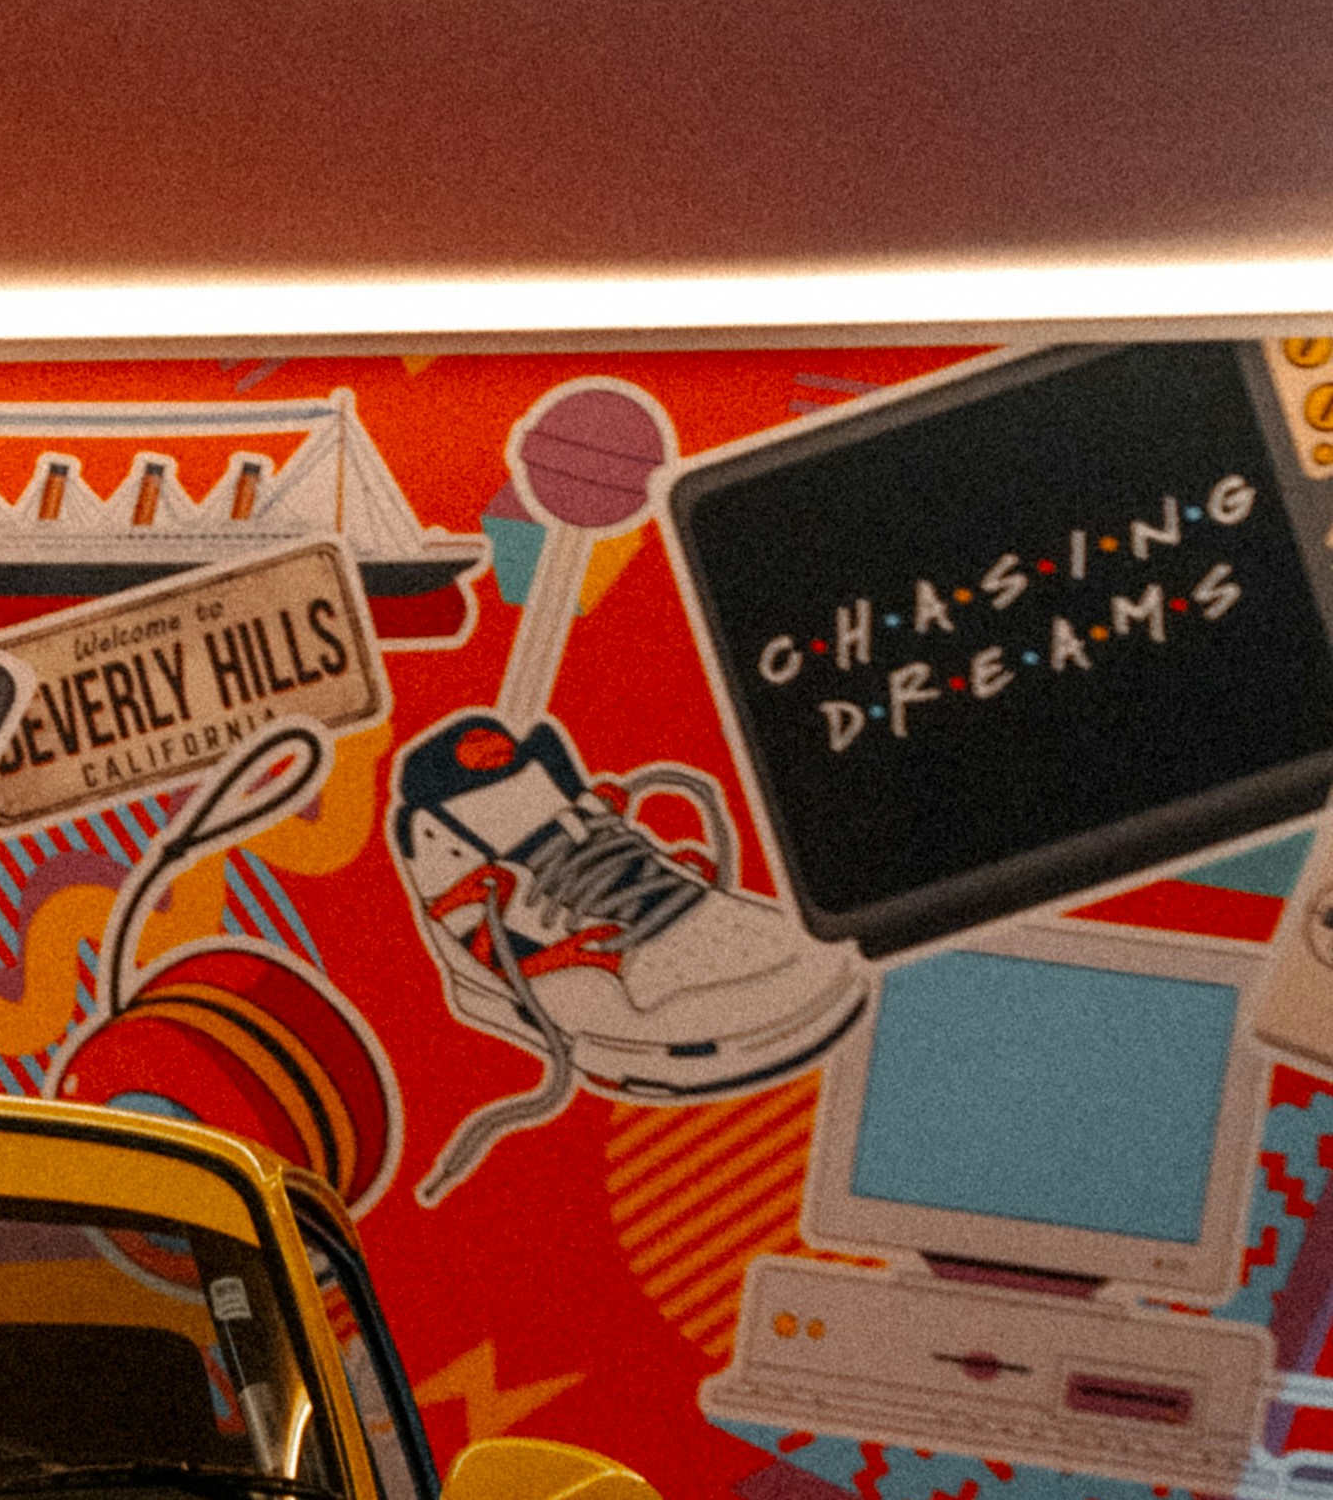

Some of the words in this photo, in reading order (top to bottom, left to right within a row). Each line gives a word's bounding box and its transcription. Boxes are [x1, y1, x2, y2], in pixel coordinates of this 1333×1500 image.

[73, 614, 183, 662] Welcome
[195, 600, 225, 624] to
[204, 597, 349, 709] HILLS
